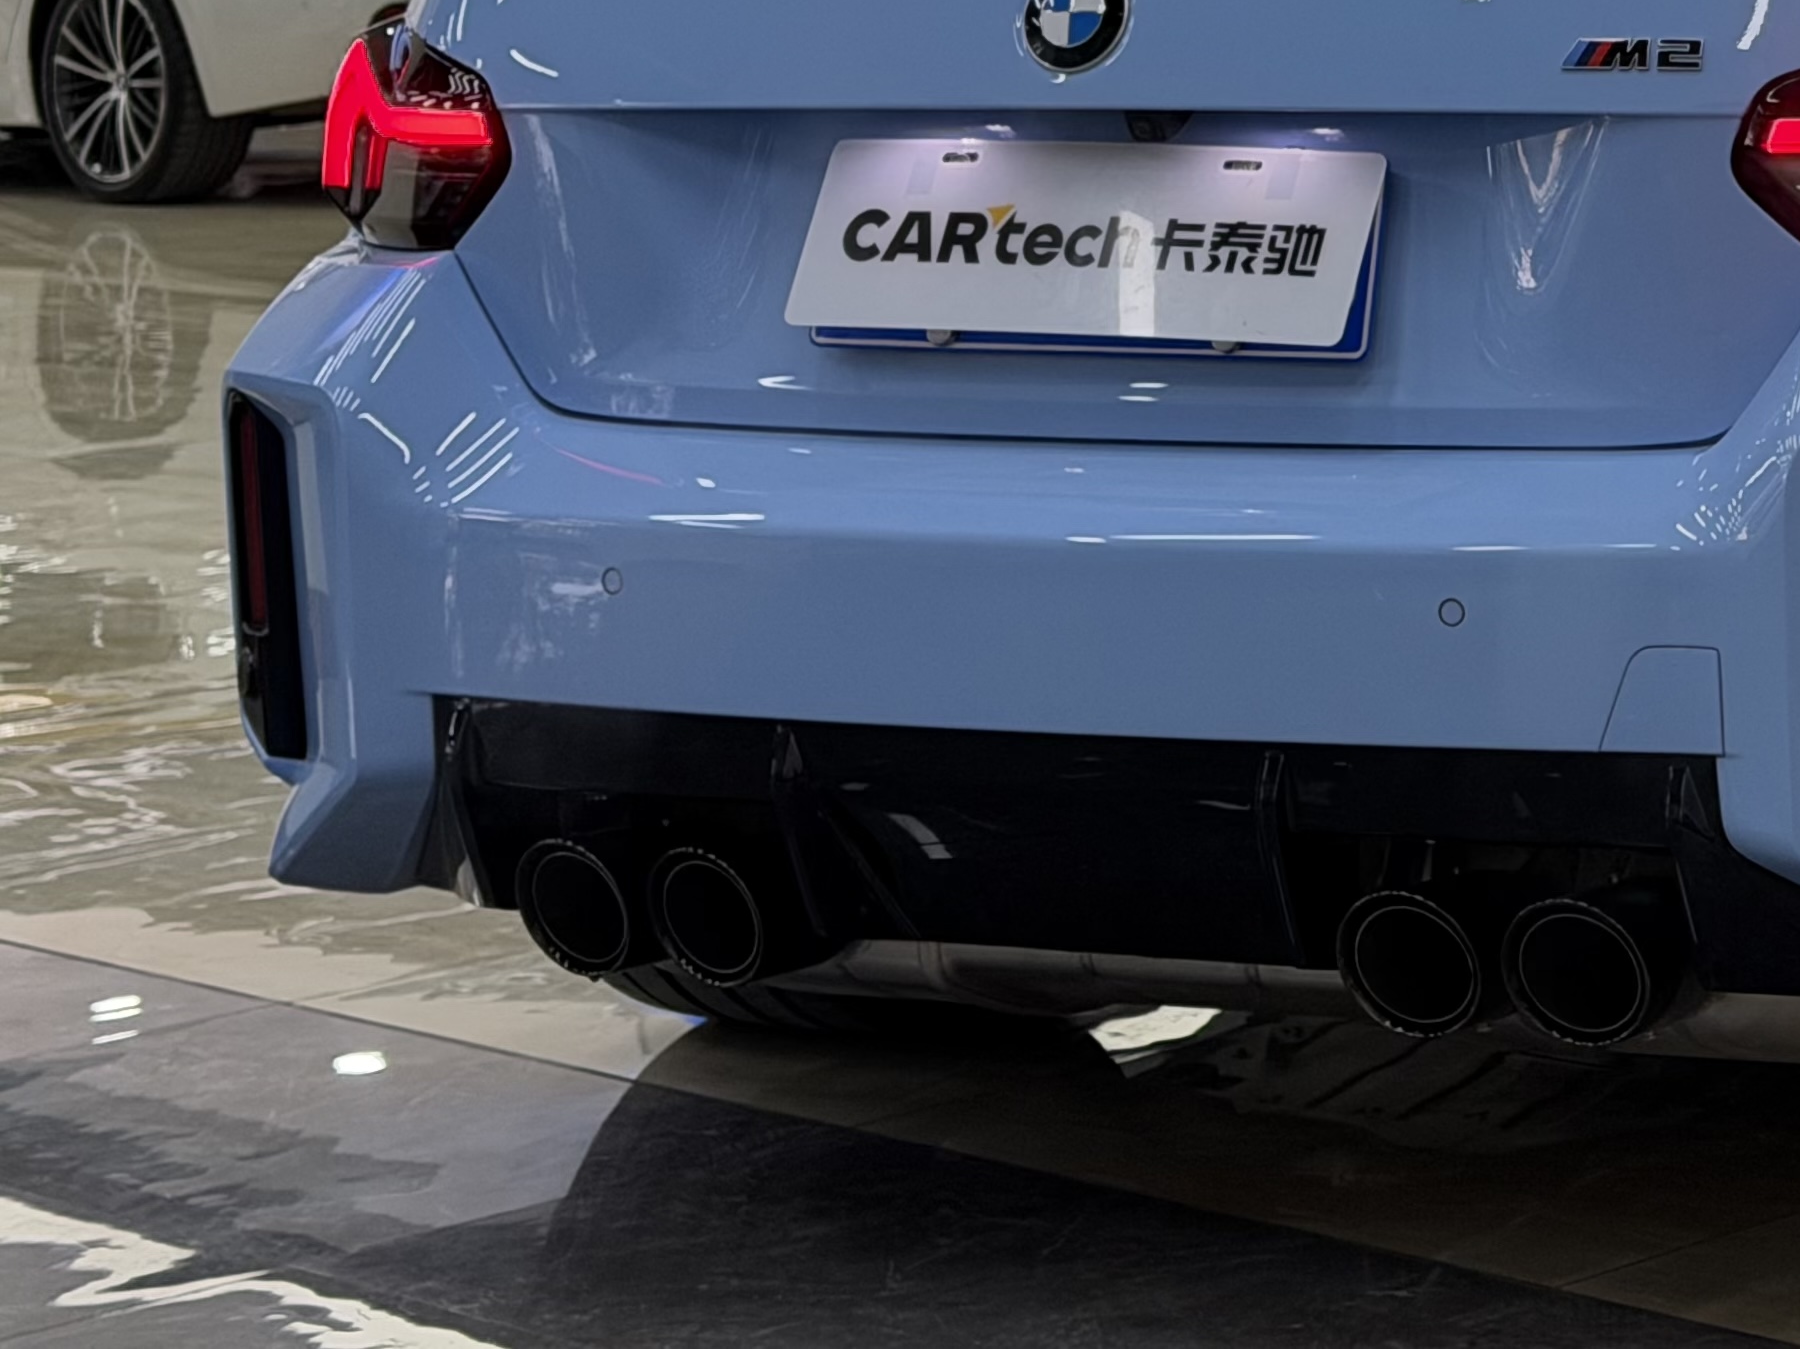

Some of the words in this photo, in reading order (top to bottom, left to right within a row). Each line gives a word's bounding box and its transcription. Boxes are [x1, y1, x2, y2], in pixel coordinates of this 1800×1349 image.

[1598, 37, 1704, 71] M2
[842, 204, 1140, 269] CARtech
[1151, 217, 1327, 278] 卡泰驰
